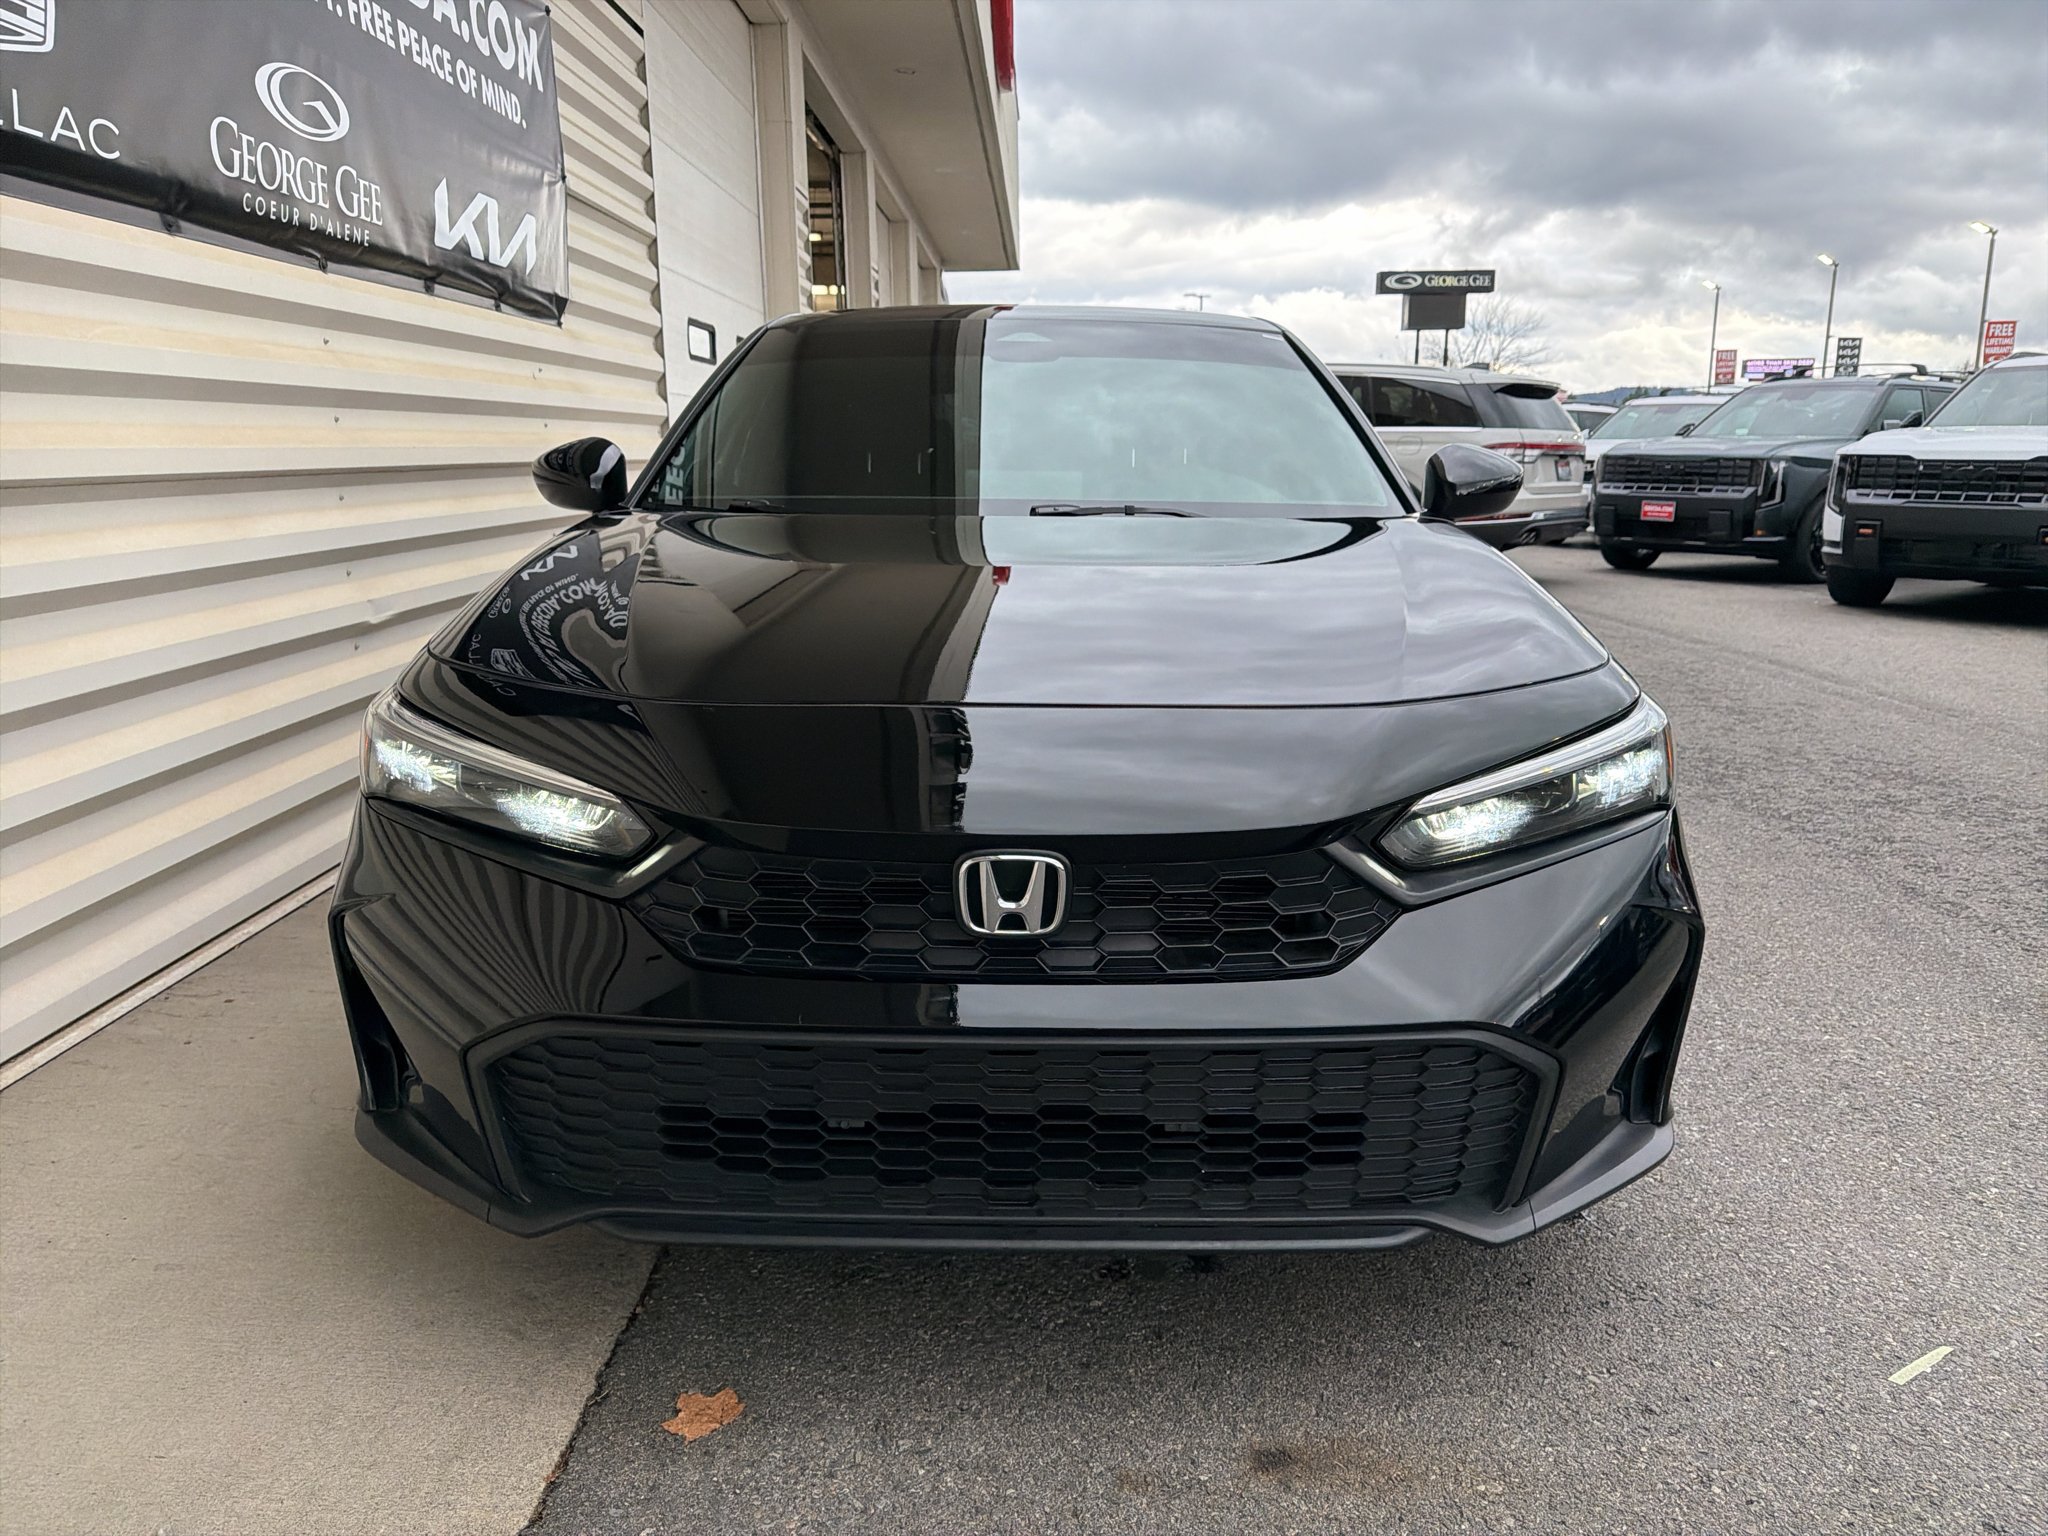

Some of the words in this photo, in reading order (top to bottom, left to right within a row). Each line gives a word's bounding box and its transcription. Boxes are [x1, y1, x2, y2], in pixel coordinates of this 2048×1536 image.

[350, 0, 396, 49] FREE
[397, 19, 454, 86] PEACE
[455, 58, 477, 99] OF
[481, 74, 528, 130] MIND.
[409, 0, 544, 93] A.COM
[0, 88, 121, 160] LAC
[209, 116, 330, 209] GEORGE
[335, 165, 384, 226] GEE
[242, 192, 301, 227] COEUR
[309, 213, 371, 248] D'ALENE
[434, 177, 537, 276] KIA
[1424, 274, 1469, 288] GEORGE
[1469, 273, 1492, 287] GEE
[1988, 323, 2014, 337] FREE
